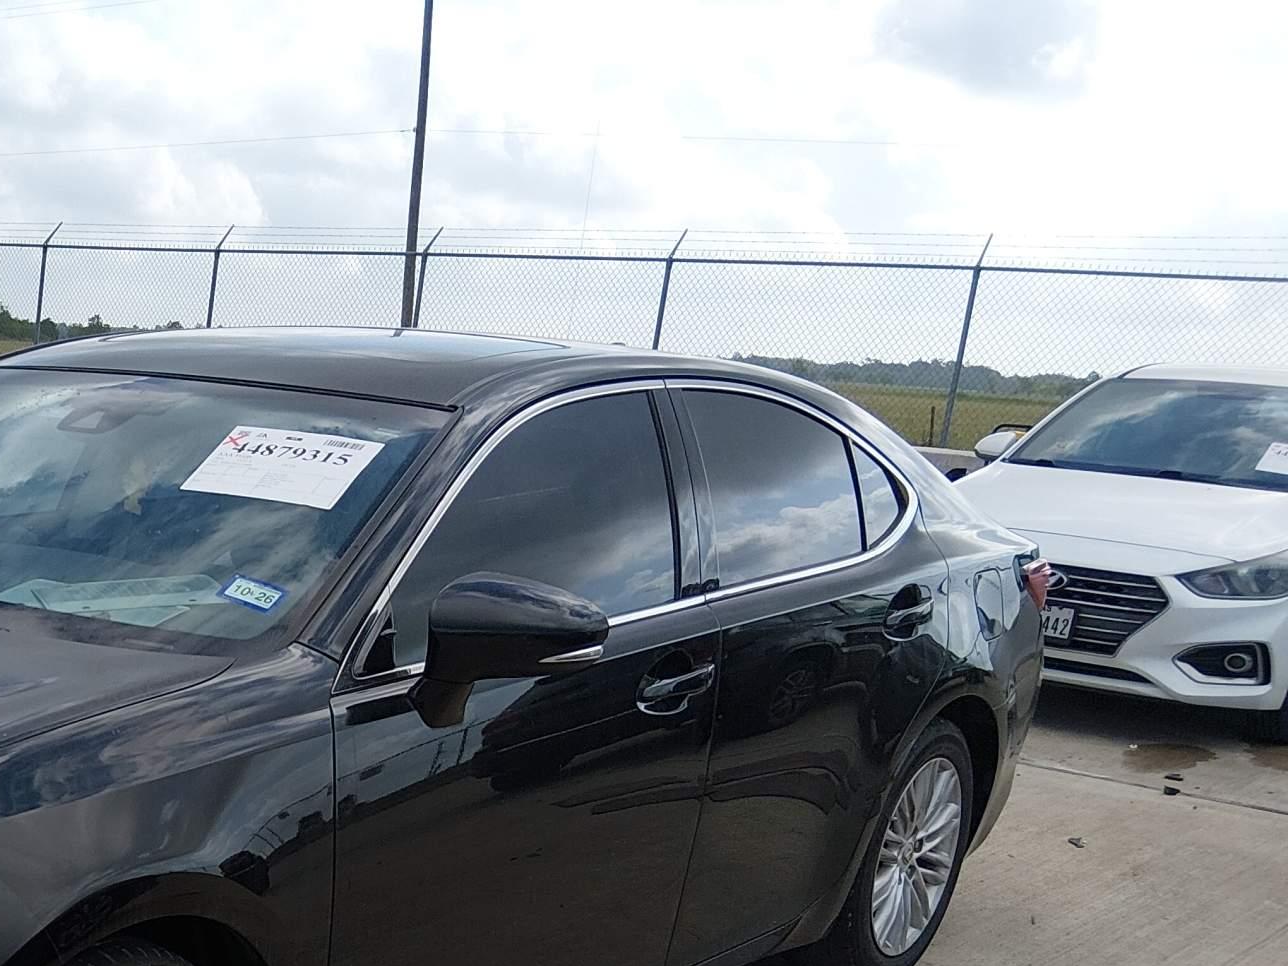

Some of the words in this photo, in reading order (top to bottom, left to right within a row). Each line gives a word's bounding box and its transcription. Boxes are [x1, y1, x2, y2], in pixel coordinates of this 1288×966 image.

[232, 442, 353, 466] 44879315
[233, 584, 252, 597] 10
[254, 591, 275, 604] 26
